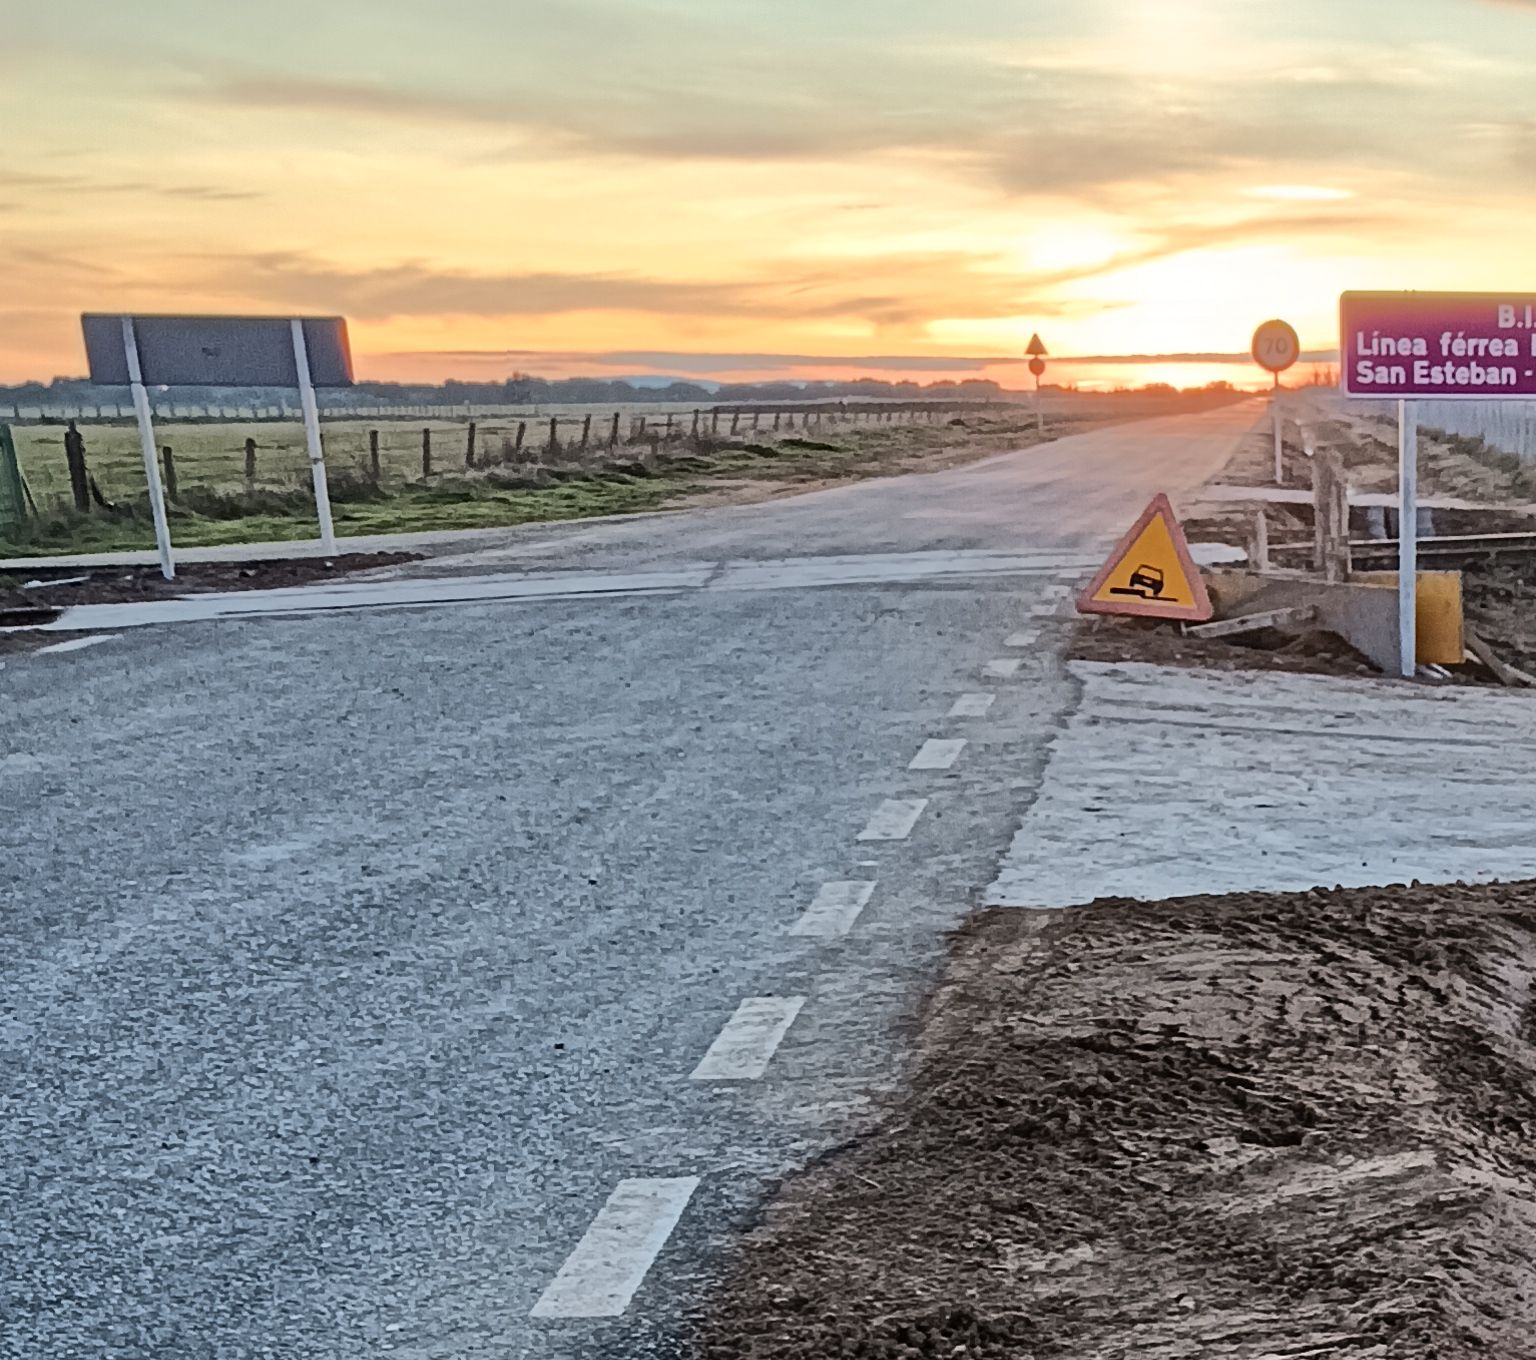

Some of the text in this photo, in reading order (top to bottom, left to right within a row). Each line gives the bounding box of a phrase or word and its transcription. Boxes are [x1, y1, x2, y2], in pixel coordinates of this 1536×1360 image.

[1263, 337, 1289, 355] 70
[1356, 330, 1428, 357] Línea
[1439, 331, 1519, 357] férrea
[1356, 360, 1406, 385] San
[1413, 360, 1517, 386] Esteban
